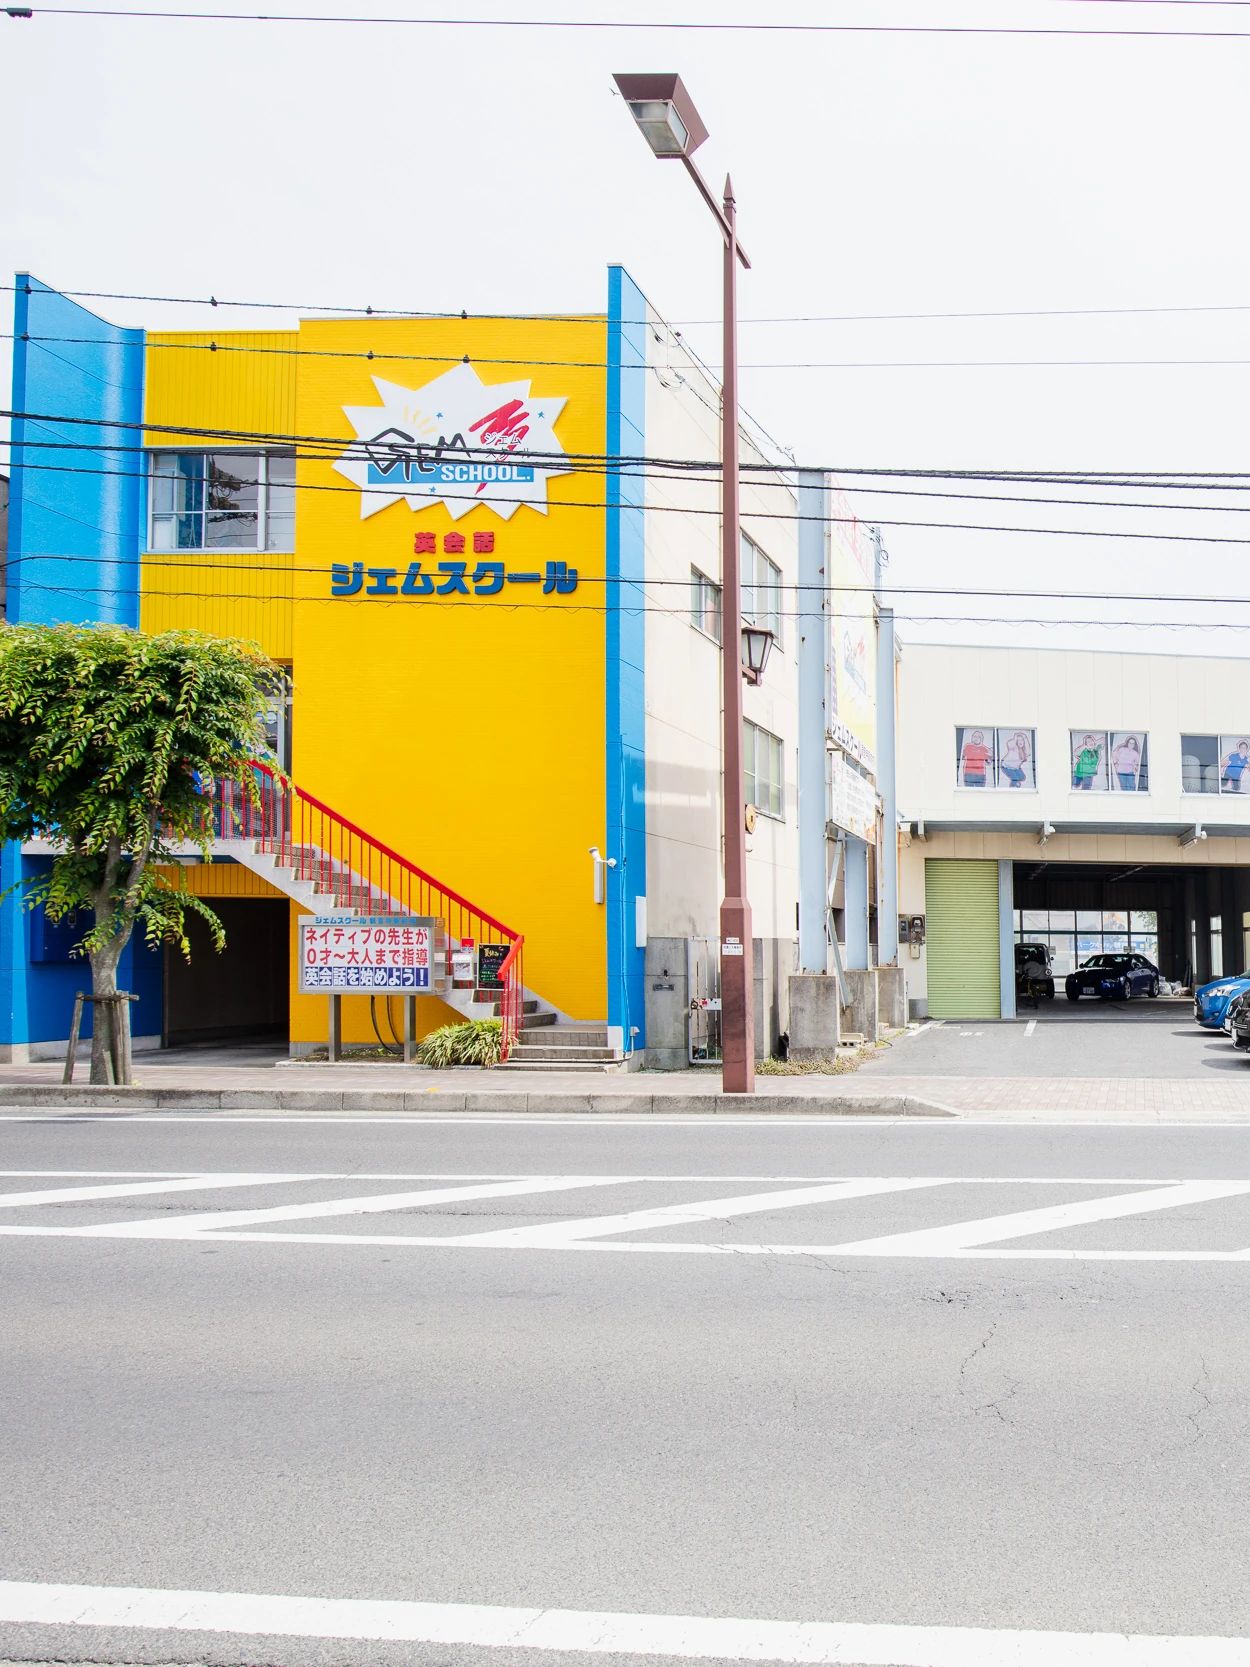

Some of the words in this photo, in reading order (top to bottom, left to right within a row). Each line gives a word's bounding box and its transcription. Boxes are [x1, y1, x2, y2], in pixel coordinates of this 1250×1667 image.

[486, 433, 522, 446] ジェム
[414, 531, 495, 554] 英会話
[331, 561, 577, 596] ジェムスクール
[315, 916, 367, 925] ジェムスクール
[305, 927, 428, 946] ネイティブの先生が
